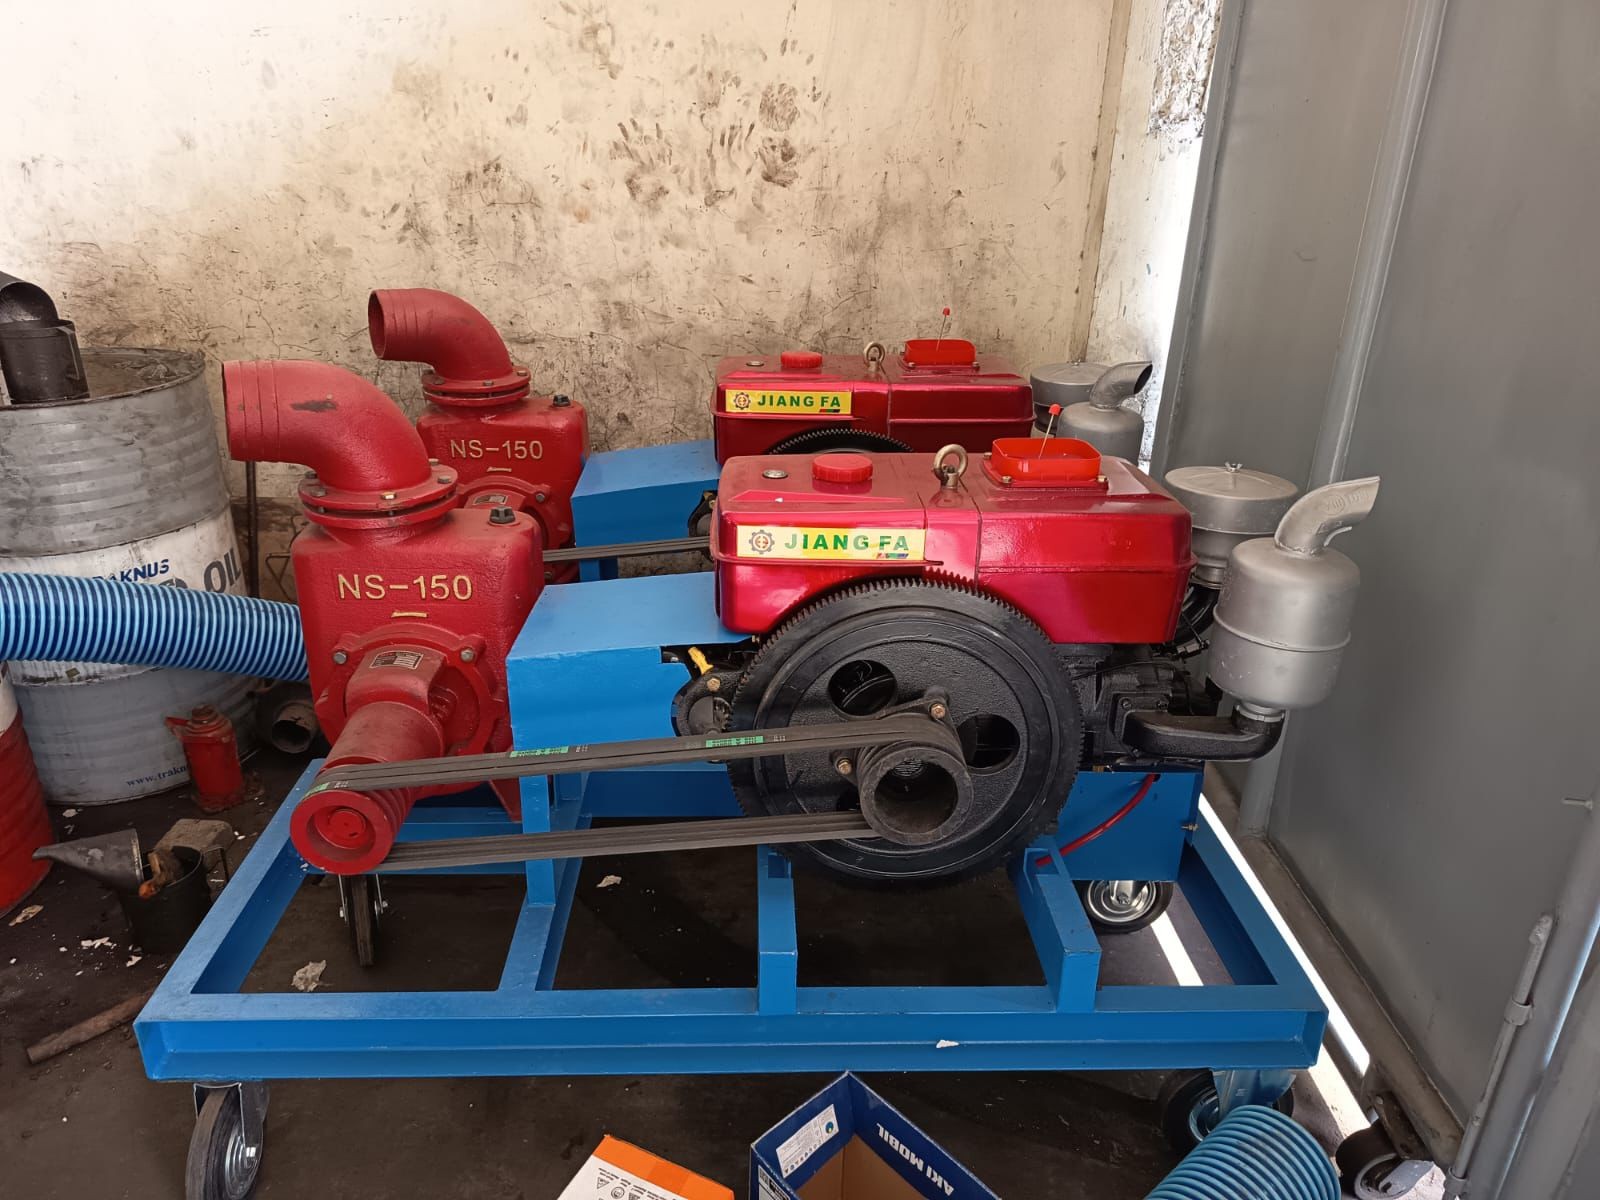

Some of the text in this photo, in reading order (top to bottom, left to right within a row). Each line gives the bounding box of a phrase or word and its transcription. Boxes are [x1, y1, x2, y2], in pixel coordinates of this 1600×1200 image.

[757, 394, 841, 408] JIANG FA
[450, 439, 543, 459] NS-150
[784, 533, 909, 551] JIANG FA
[203, 548, 242, 594] OIL
[337, 573, 473, 600] NS-150
[876, 1122, 924, 1172] MOBIL
[925, 1165, 955, 1197] AKI
